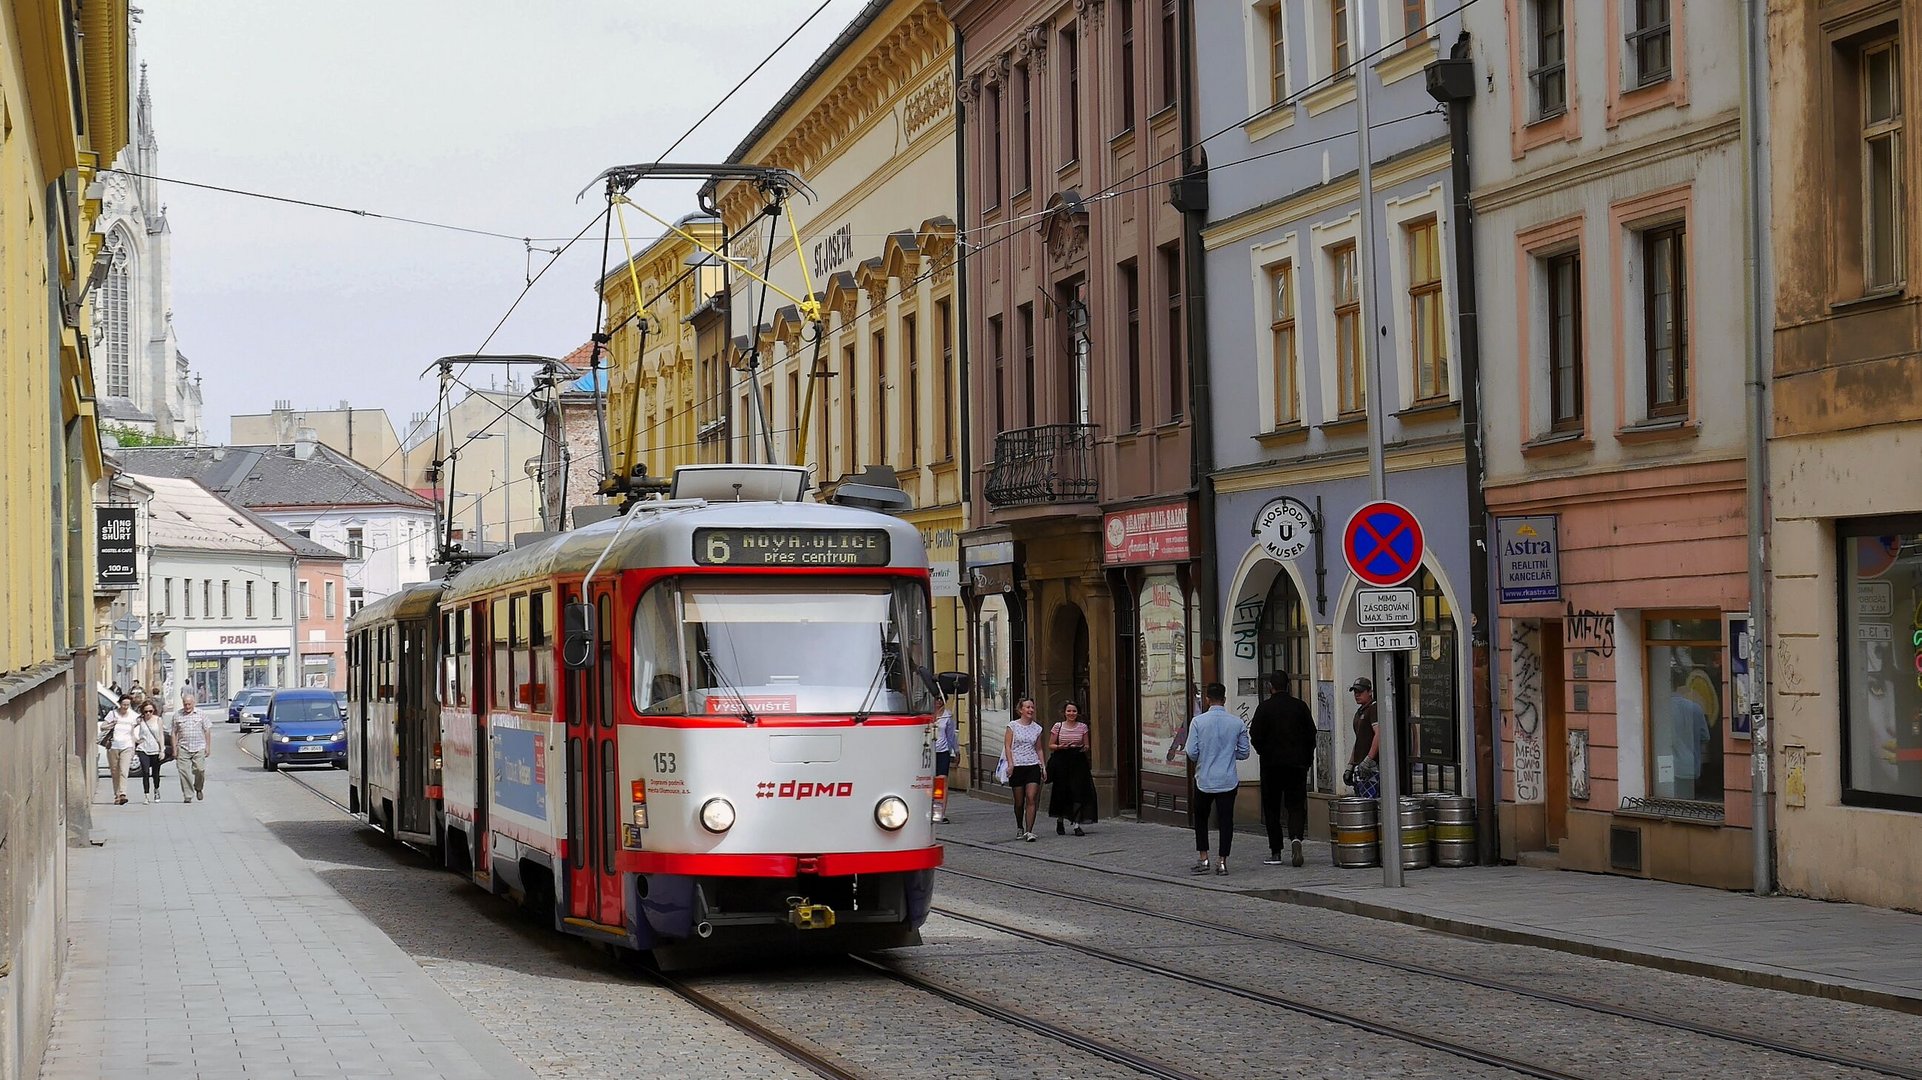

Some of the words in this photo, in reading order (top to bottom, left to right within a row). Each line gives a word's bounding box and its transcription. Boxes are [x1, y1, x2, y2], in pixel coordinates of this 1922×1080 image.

[1262, 505, 1308, 529] HOSPODA
[706, 532, 731, 564] 6
[1266, 541, 1306, 559] MUSEA
[1504, 538, 1553, 557] Astra
[764, 546, 796, 563] přes
[801, 549, 858, 564] centrum
[108, 564, 122, 572] 100
[1511, 558, 1549, 571] REALITNÍ
[1509, 570, 1552, 582] KANCELÁŘ
[1152, 583, 1171, 608] Nails
[1505, 588, 1557, 598] www.rkastra.cz
[1363, 602, 1410, 612] ZÁSOBOVÁNÍ
[1386, 613, 1393, 621] 15
[219, 635, 257, 644] PRAHA
[1374, 636, 1385, 647] 13
[1390, 638, 1401, 647] m
[653, 752, 676, 774] 153
